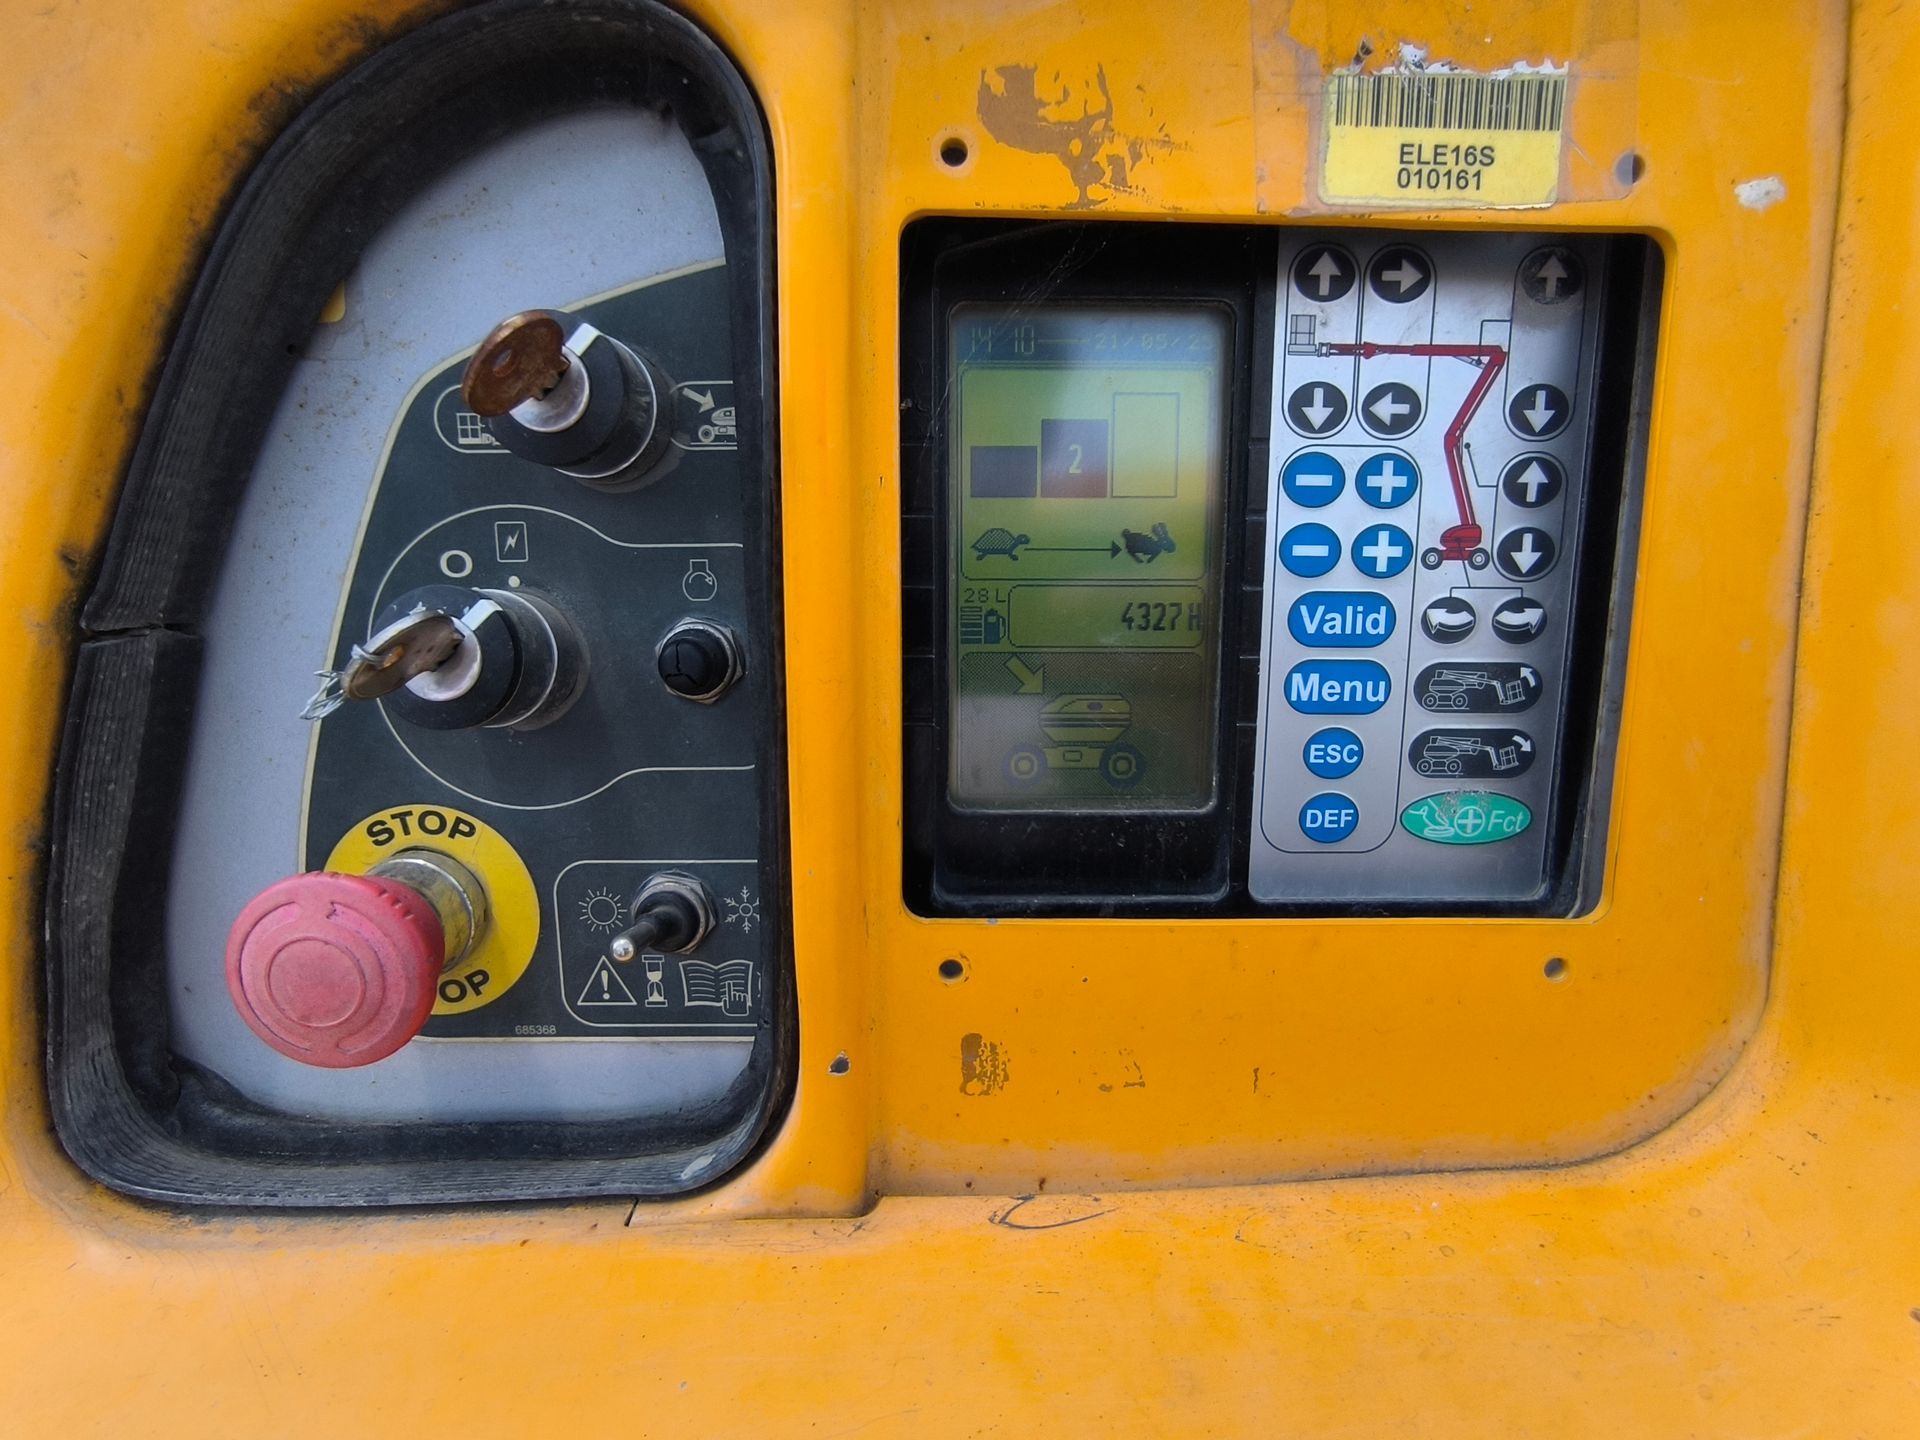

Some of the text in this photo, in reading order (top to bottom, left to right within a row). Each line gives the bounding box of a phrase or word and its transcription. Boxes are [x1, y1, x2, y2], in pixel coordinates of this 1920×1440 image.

[1399, 143, 1495, 167] ELE16S
[1397, 168, 1482, 191] 010161
[1069, 444, 1082, 474] 2
[964, 588, 1007, 603] 28 L
[1121, 602, 1202, 631] 4327 H
[1299, 605, 1387, 635] Valid
[1290, 673, 1386, 702] Menu
[1309, 744, 1358, 763] ESC
[366, 810, 477, 847] STOP
[1305, 809, 1354, 828] DEF
[1487, 810, 1523, 833] Fct
[438, 969, 490, 1003] OP
[515, 1025, 556, 1035] 685368
